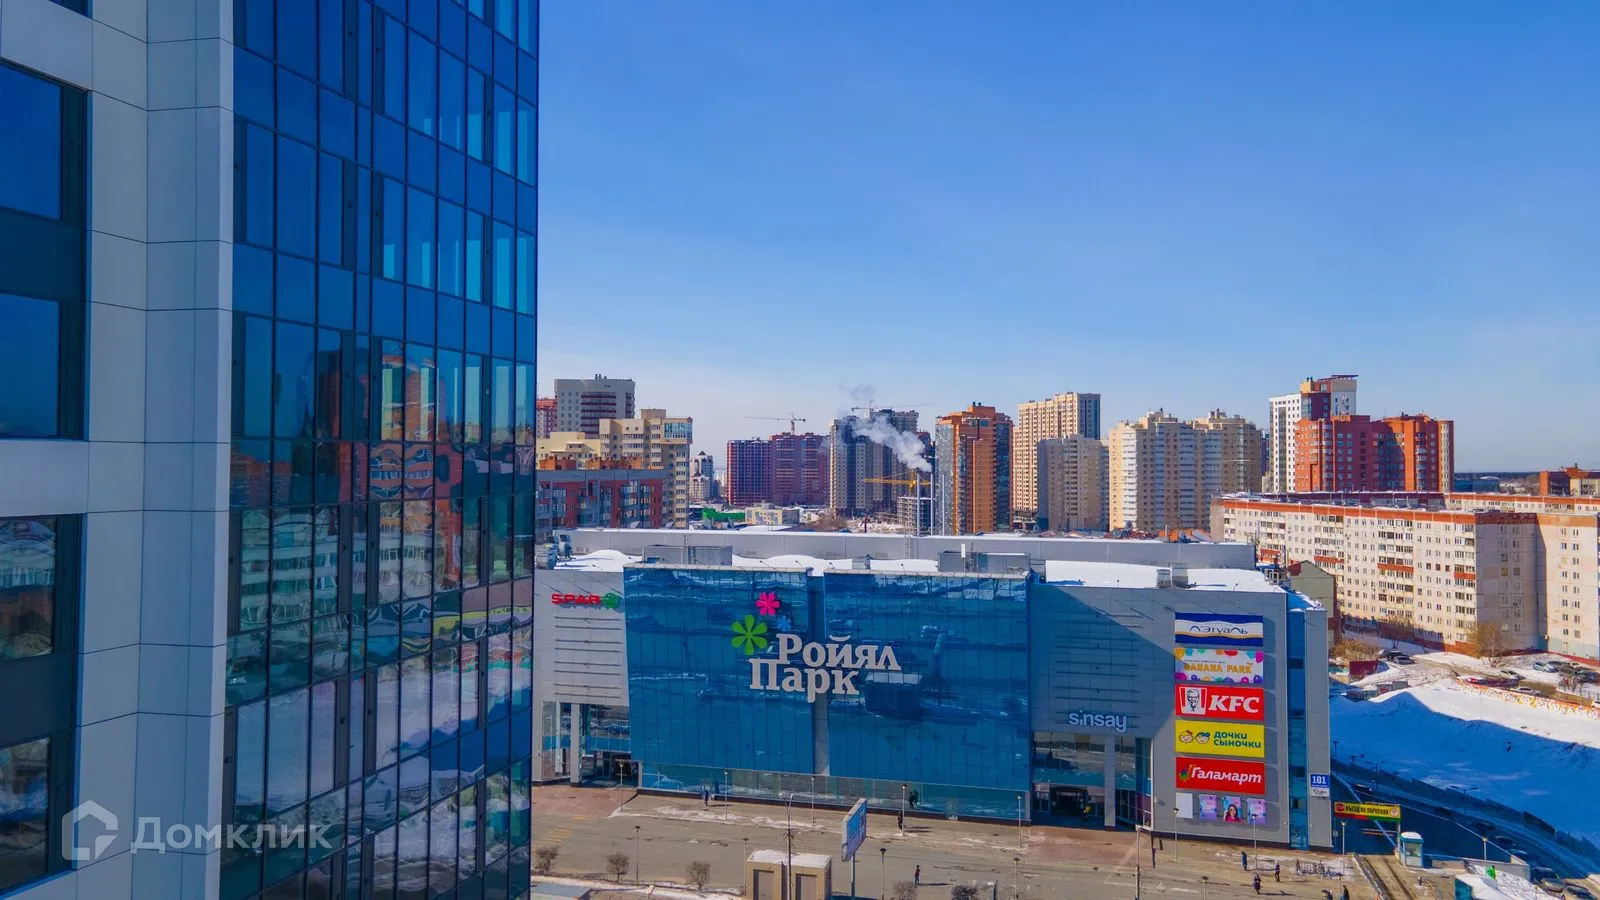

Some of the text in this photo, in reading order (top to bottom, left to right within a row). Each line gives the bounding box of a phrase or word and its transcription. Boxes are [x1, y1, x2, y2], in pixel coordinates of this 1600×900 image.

[551, 594, 601, 605] SPAR
[776, 633, 902, 671] Ройял
[1227, 663, 1253, 674] PARK
[749, 658, 860, 703] Парк
[1208, 694, 1260, 714] KFC
[1068, 709, 1127, 733] sinsay
[1191, 766, 1262, 786] Галамарт
[1311, 775, 1327, 785] 101
